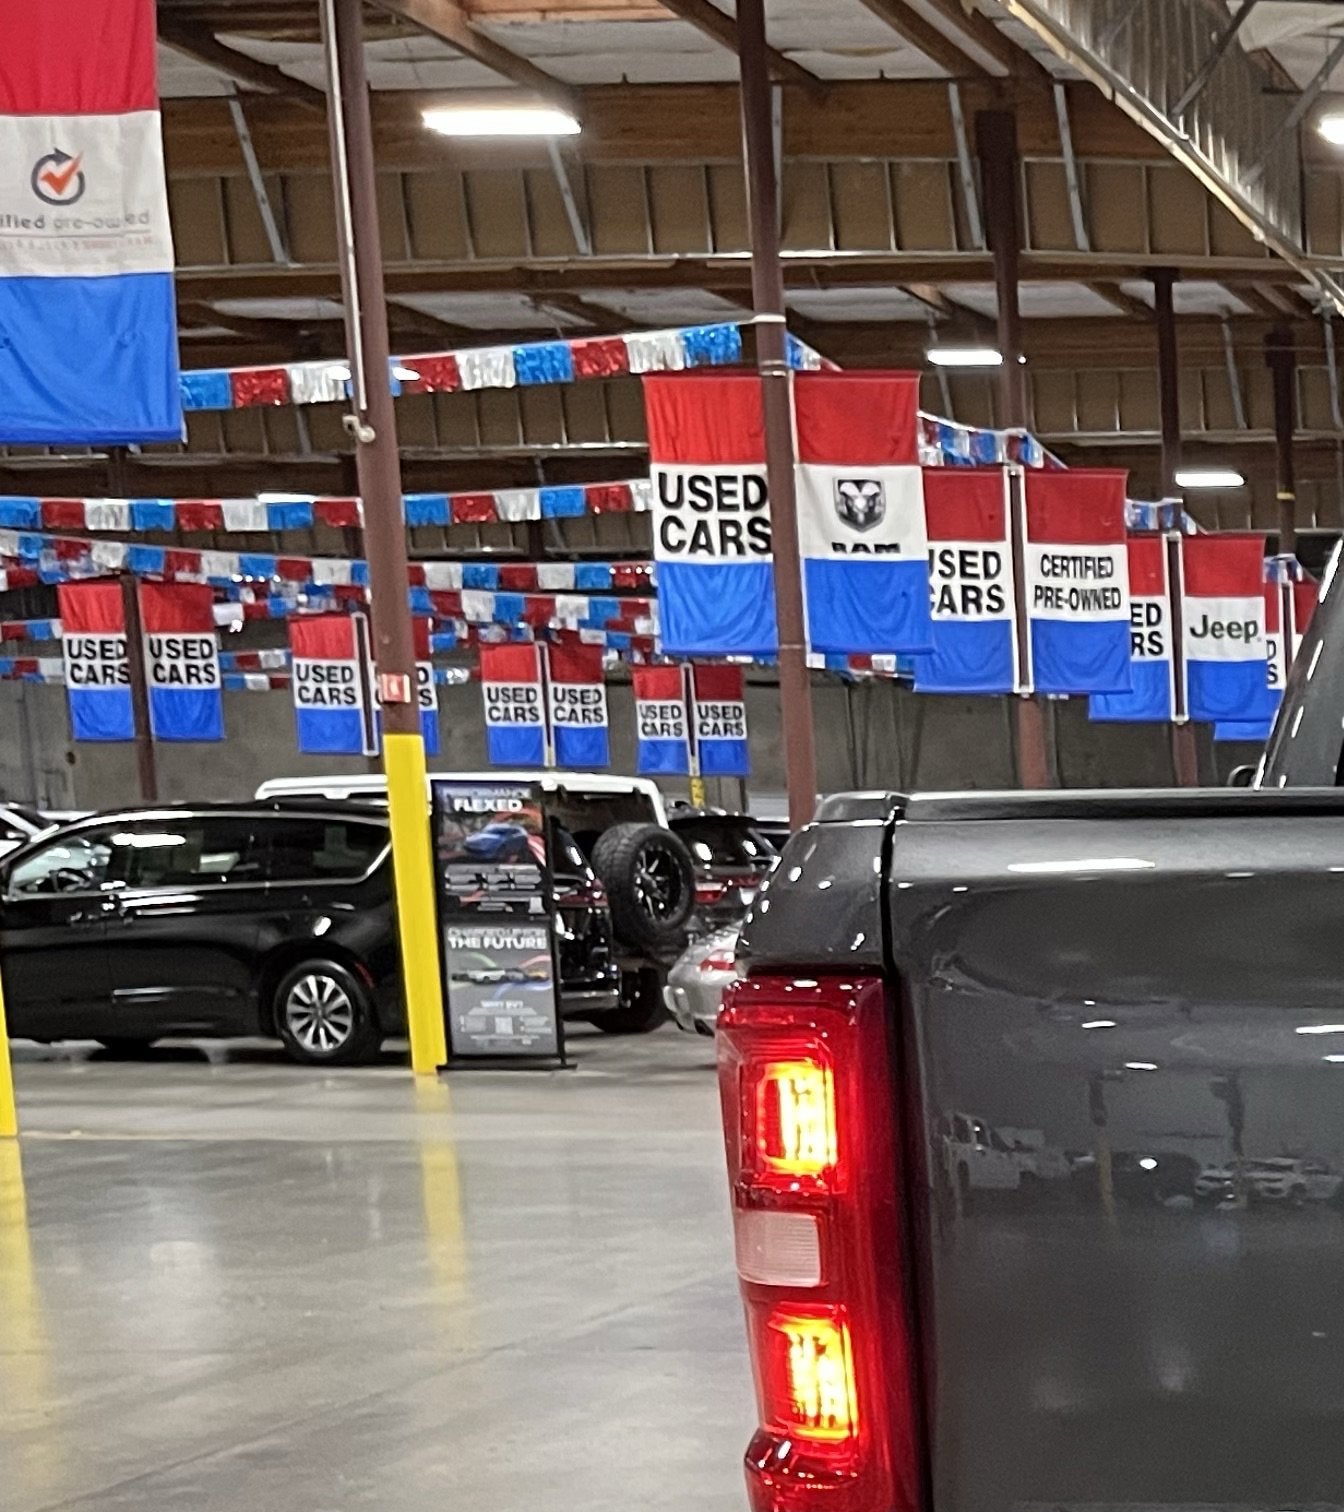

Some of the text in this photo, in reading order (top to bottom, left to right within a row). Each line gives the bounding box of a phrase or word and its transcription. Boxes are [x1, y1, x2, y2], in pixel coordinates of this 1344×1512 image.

[658, 472, 768, 513] USED
[660, 515, 772, 556] CARS
[930, 548, 1002, 580] SED
[1040, 553, 1114, 579] CERTIFIED
[930, 583, 1006, 615] ARS
[1034, 584, 1122, 612] PRE-OWNED
[1131, 603, 1162, 627] ED
[1189, 614, 1259, 644] Jeep
[67, 638, 128, 660] USED
[149, 638, 214, 660] USED
[1131, 631, 1165, 657] RS
[70, 663, 132, 684] CARS
[153, 663, 216, 685] CARS
[295, 663, 354, 684] USED
[298, 686, 357, 705] CARS
[487, 687, 538, 704] USED
[553, 687, 603, 705] USED
[488, 706, 540, 722] CARS
[554, 706, 604, 724] CARS
[640, 704, 683, 720] USED
[697, 704, 743, 720] USED
[641, 722, 684, 737] CARS
[699, 722, 744, 737] CARS
[454, 799, 523, 812] FLEXED
[448, 937, 547, 949] THE FUTURE
